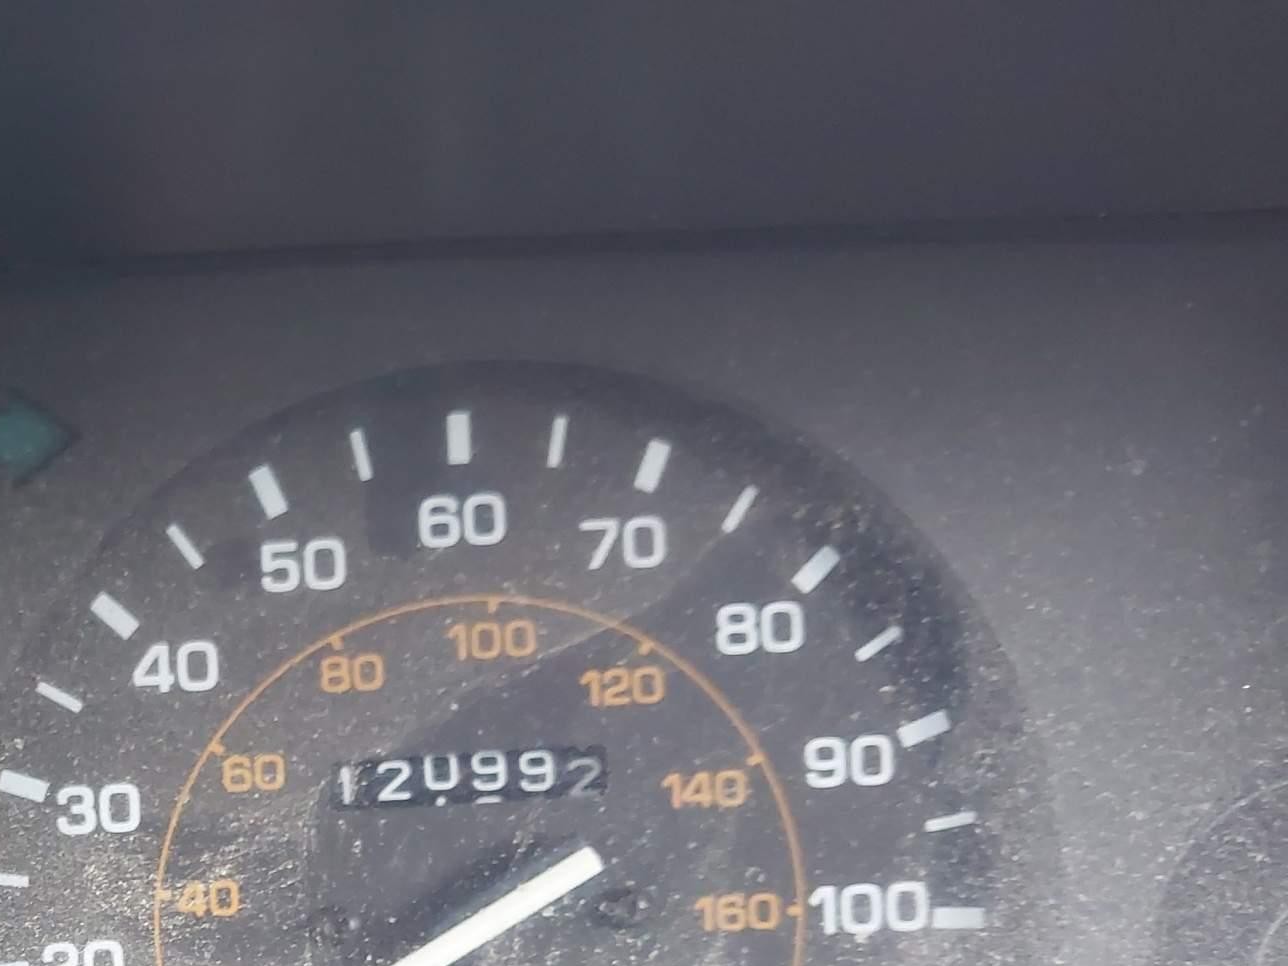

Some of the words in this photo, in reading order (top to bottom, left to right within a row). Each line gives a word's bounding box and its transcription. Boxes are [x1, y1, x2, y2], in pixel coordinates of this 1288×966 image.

[418, 491, 508, 549] 60
[578, 514, 668, 570] 70
[259, 537, 346, 593] 50
[445, 620, 538, 661] 100
[715, 600, 806, 656] 80
[132, 639, 220, 693] 40
[320, 653, 386, 694] 80
[578, 666, 666, 708] 120
[221, 754, 287, 794] 60
[803, 733, 896, 789] 90
[55, 783, 142, 836] 30
[662, 769, 749, 811] 140
[175, 879, 242, 918] 40
[694, 892, 780, 933] 160
[808, 881, 931, 935] 100
